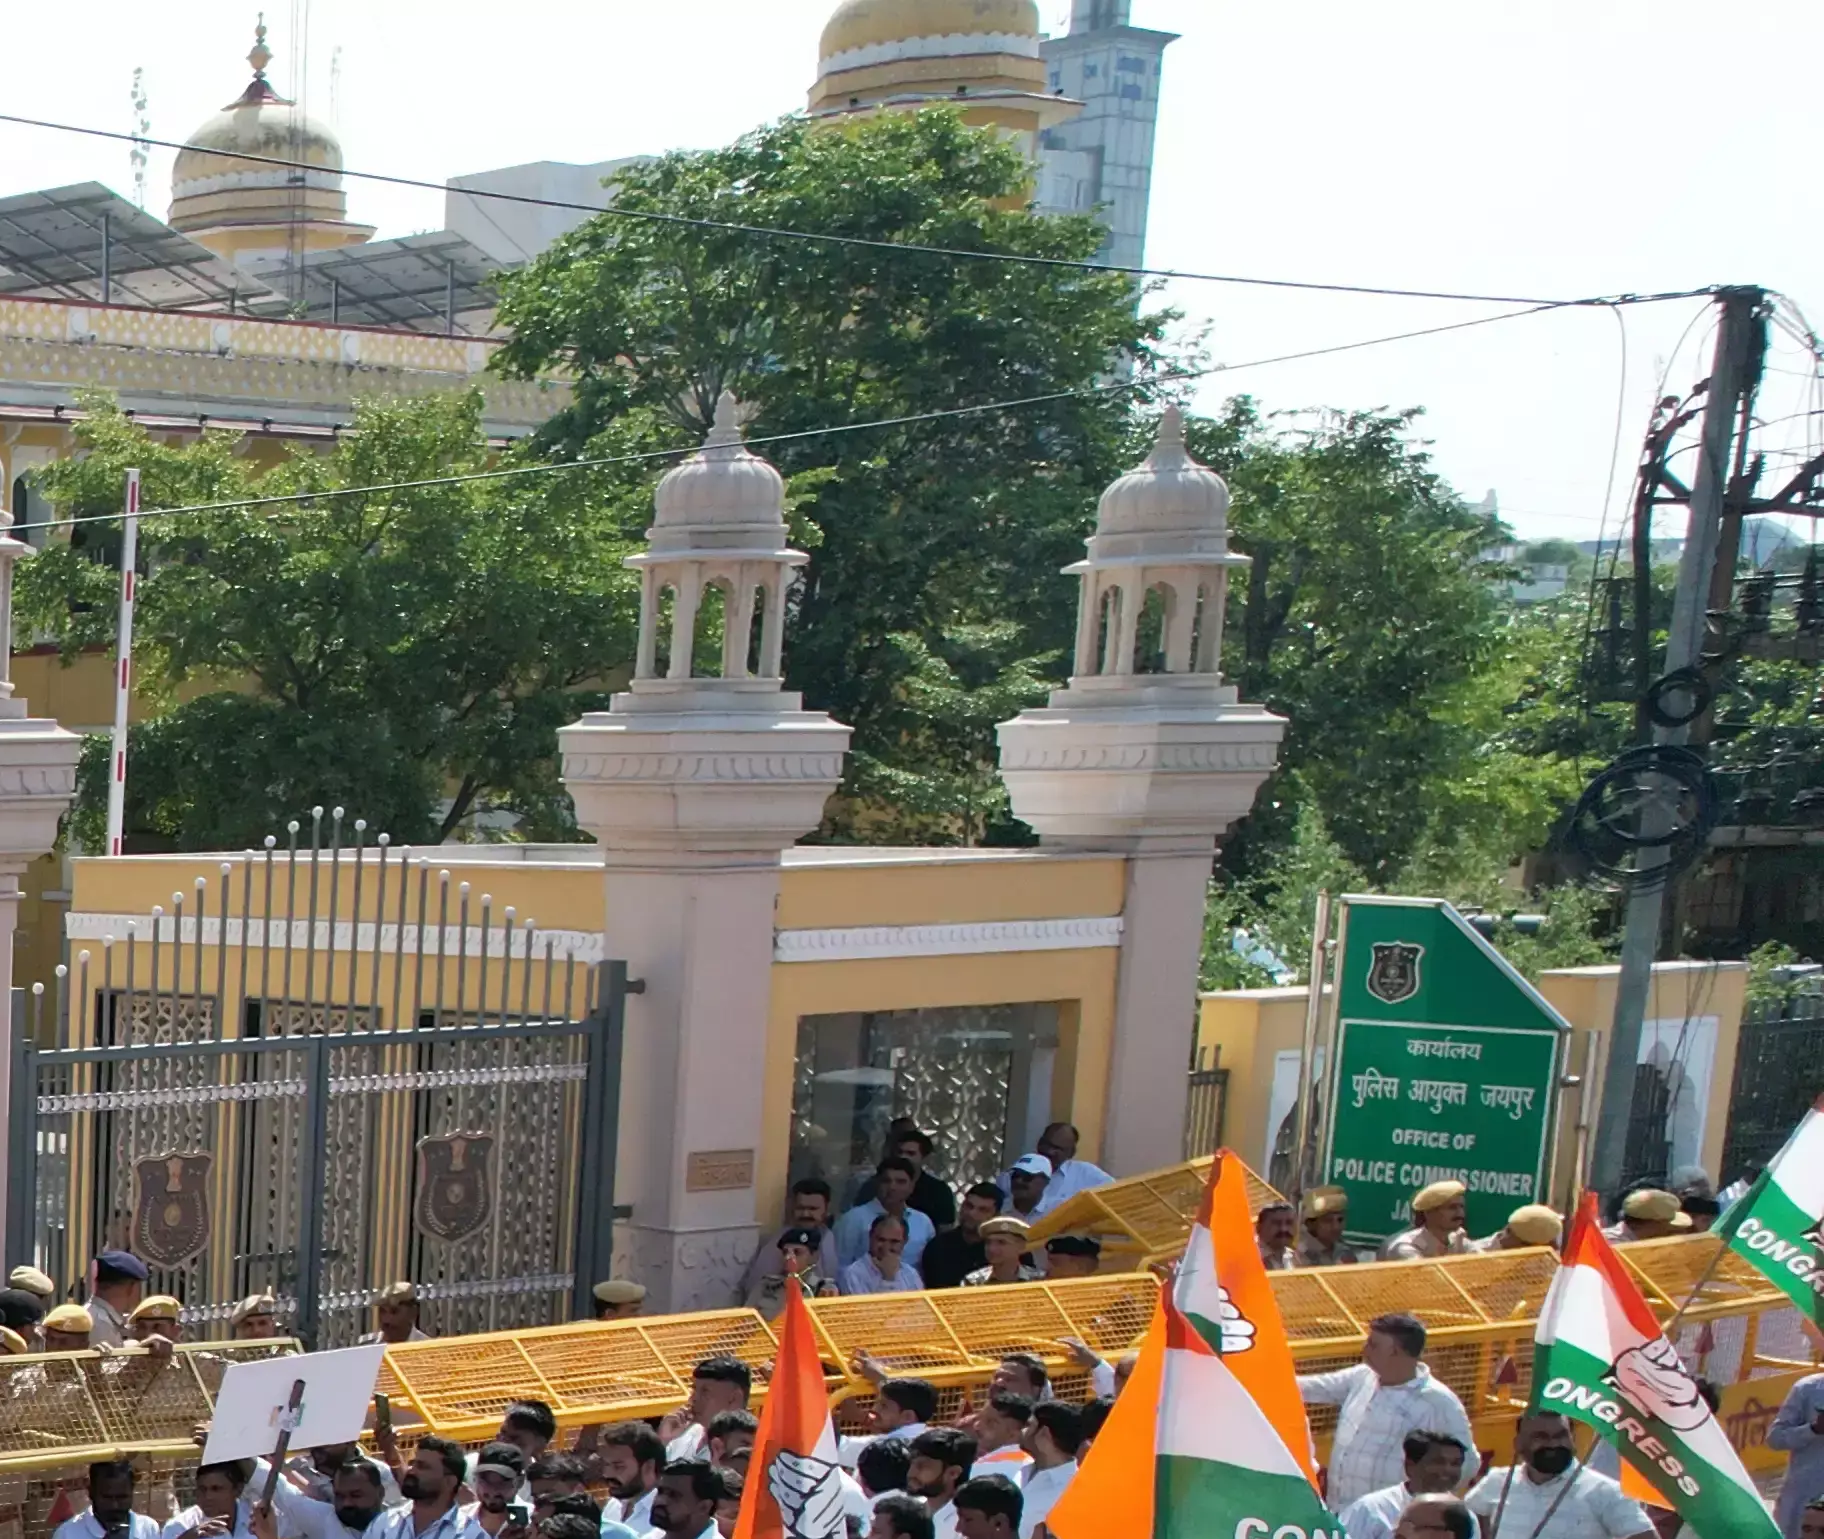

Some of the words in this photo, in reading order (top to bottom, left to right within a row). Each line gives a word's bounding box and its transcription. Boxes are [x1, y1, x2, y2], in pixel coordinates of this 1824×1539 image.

[1407, 1036, 1482, 1060] कार्यालय
[1352, 1067, 1399, 1108] पुलिस
[1408, 1079, 1468, 1114] आयुक्त
[1480, 1084, 1535, 1120] जयपुर
[1392, 1128, 1449, 1149] OFFICE
[1452, 1134, 1475, 1151] OF
[1334, 1158, 1396, 1184] POLICE
[1400, 1163, 1533, 1197] COMMISSIONER
[1542, 1377, 1700, 1497] ONGRESS
